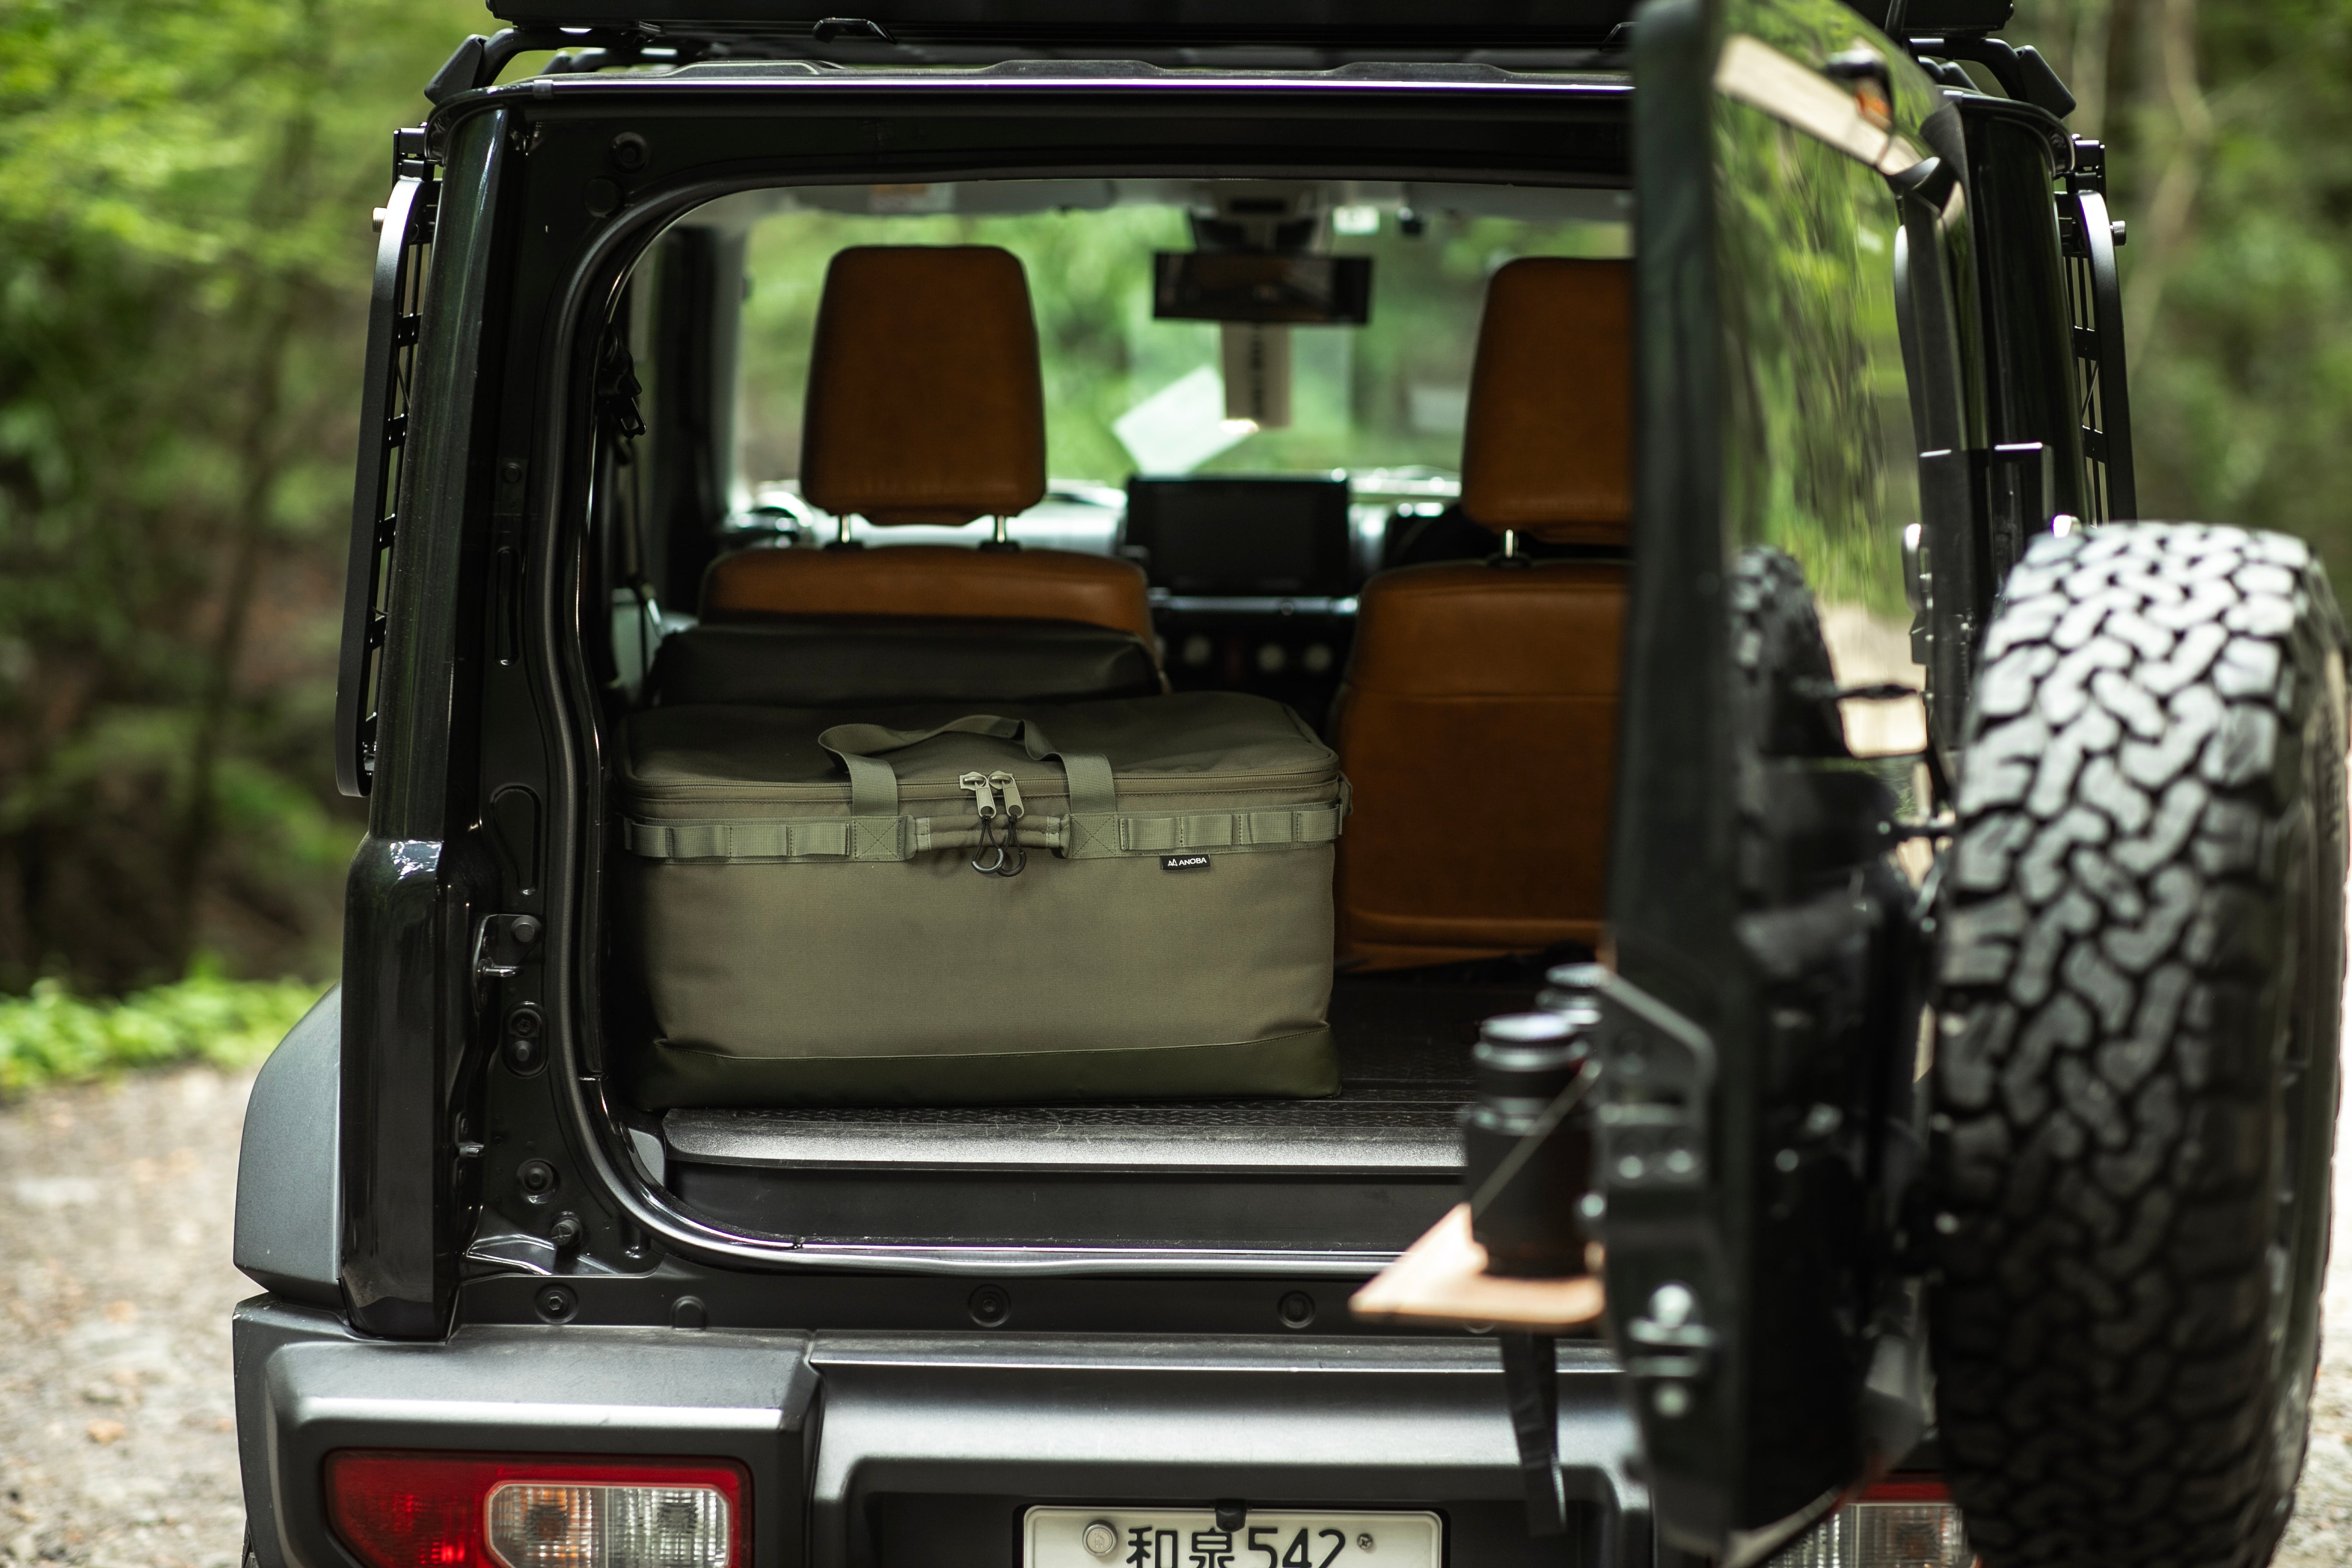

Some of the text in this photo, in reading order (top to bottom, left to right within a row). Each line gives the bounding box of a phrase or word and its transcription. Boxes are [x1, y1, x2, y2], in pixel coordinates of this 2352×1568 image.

[1179, 857, 1207, 865] ANOBA
[1126, 1527, 1235, 1568] 和泉
[1248, 1527, 1345, 1568] 542
